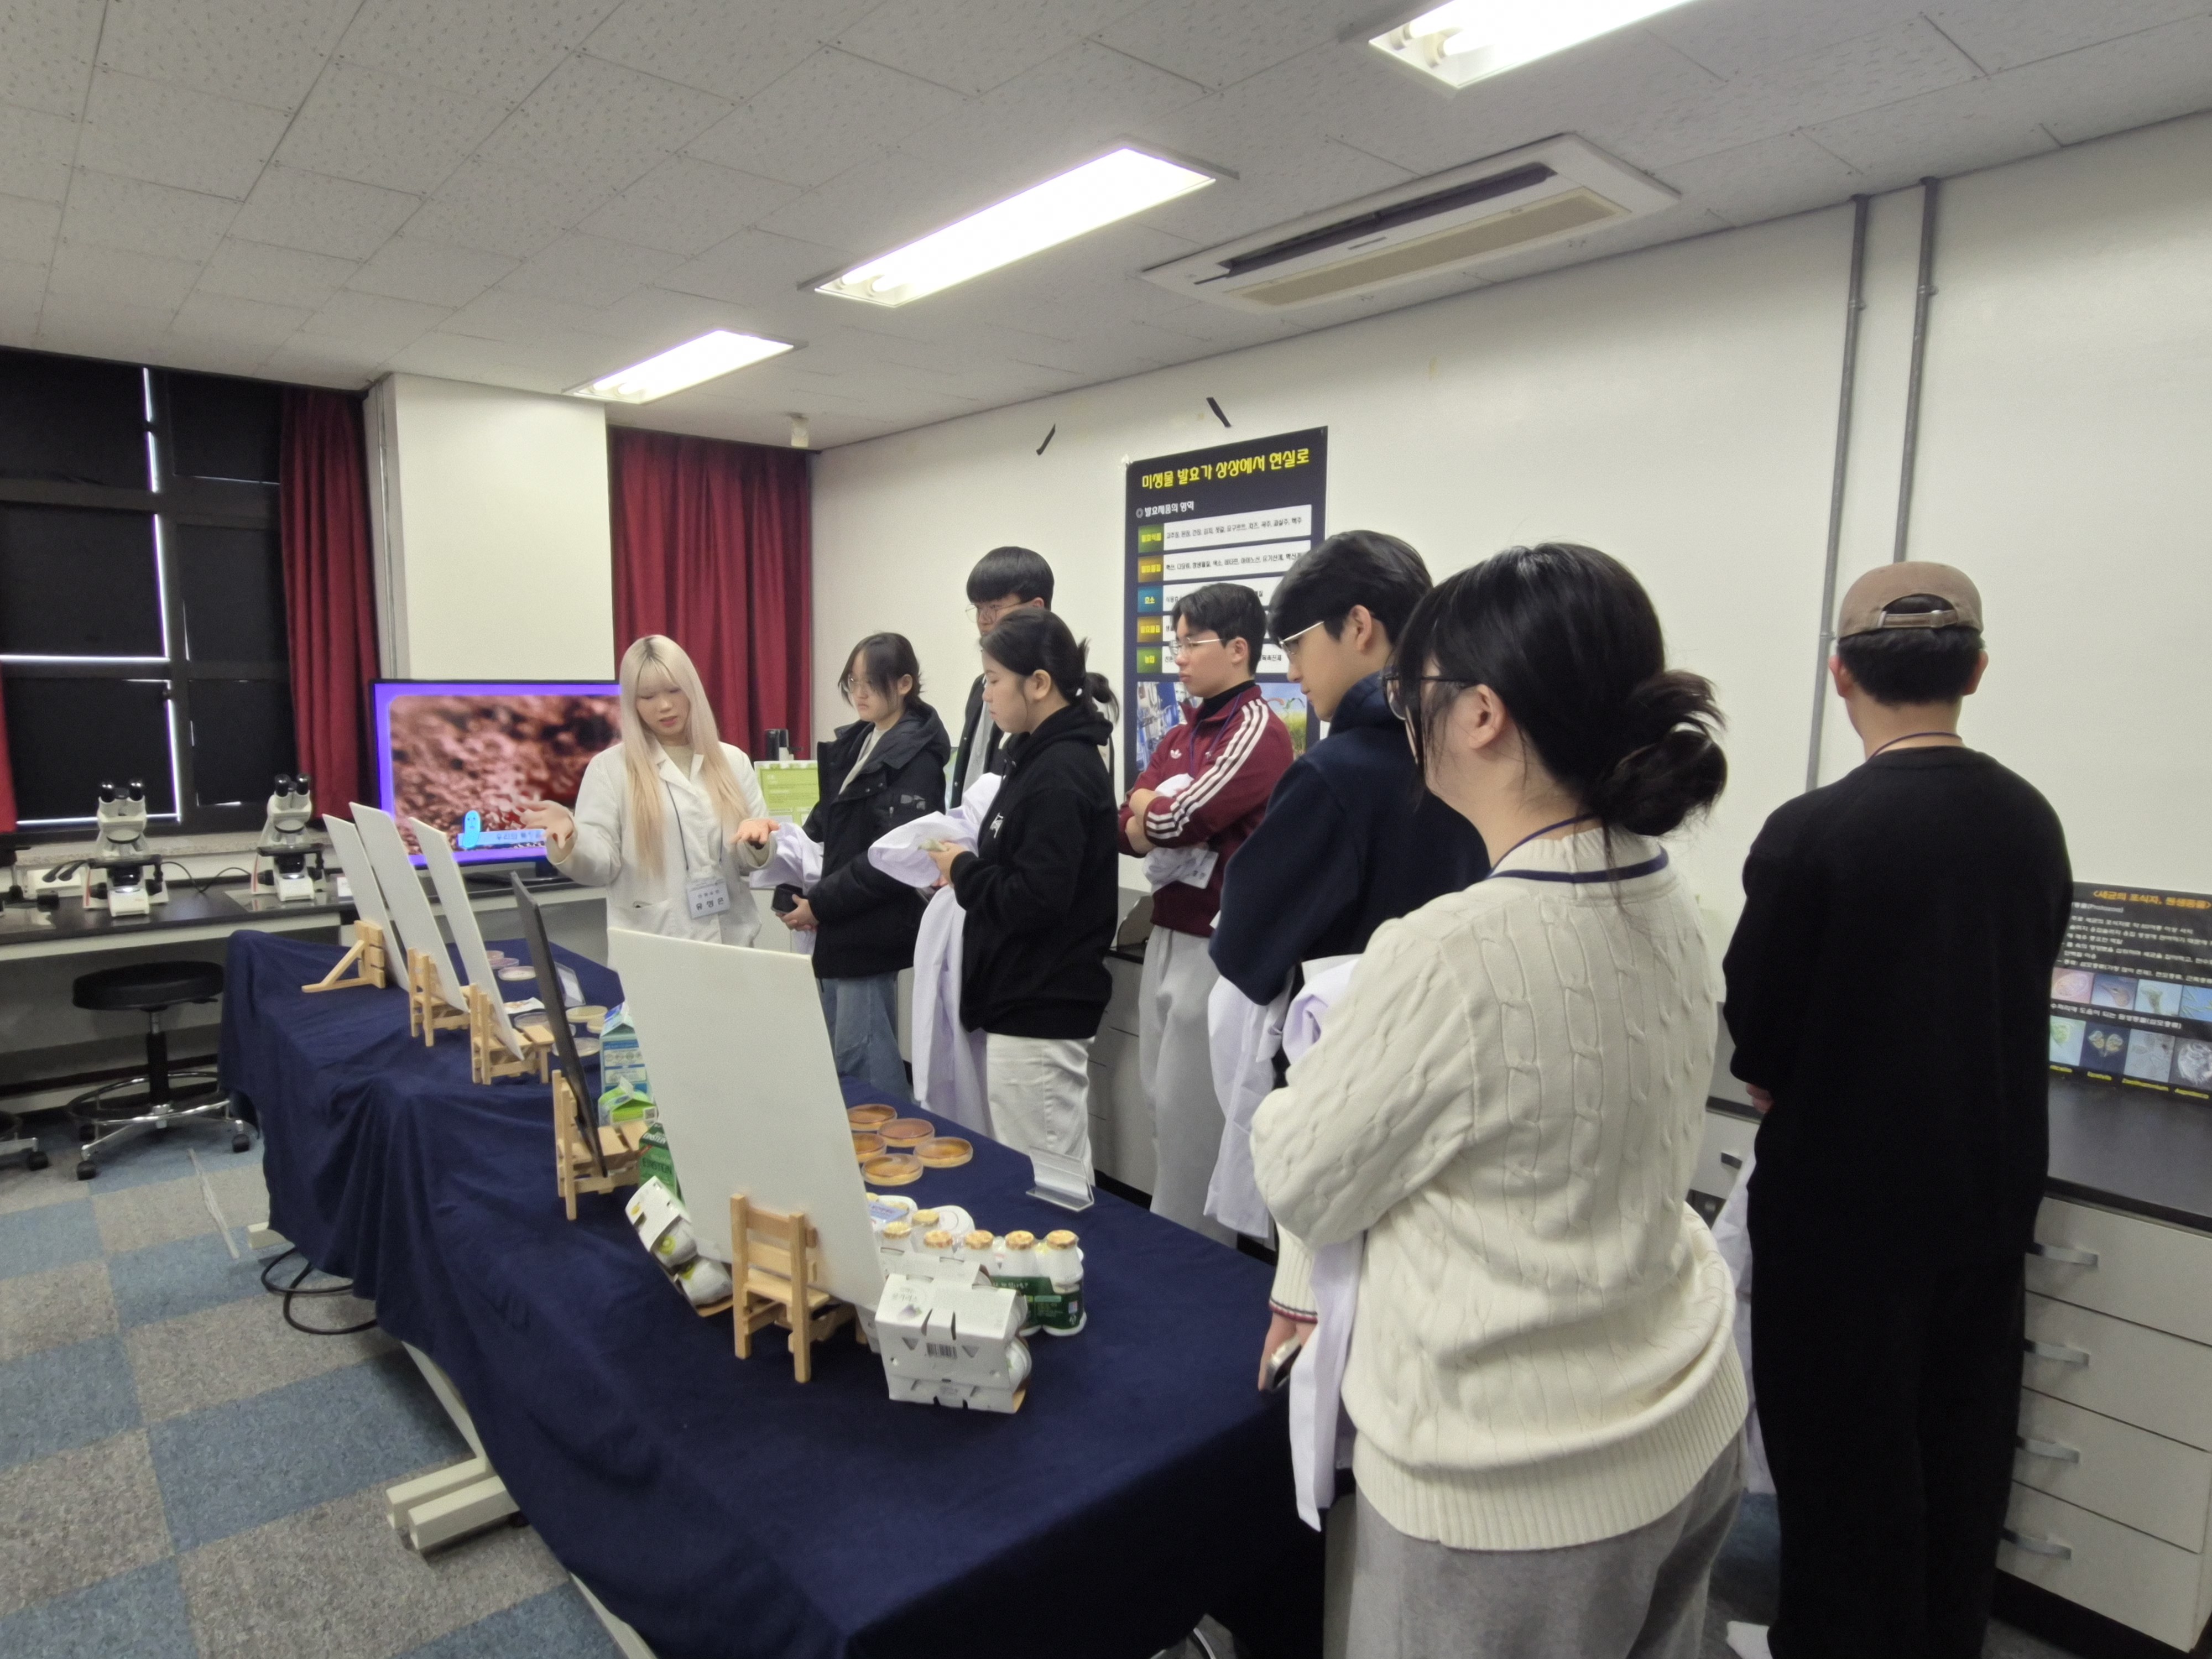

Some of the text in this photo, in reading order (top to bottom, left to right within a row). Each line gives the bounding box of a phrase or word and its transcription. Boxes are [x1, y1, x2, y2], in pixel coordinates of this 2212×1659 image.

[1142, 471, 1173, 489] 미생물
[1216, 455, 1265, 478] 상상에서
[1145, 503, 1178, 517] 발효제품의
